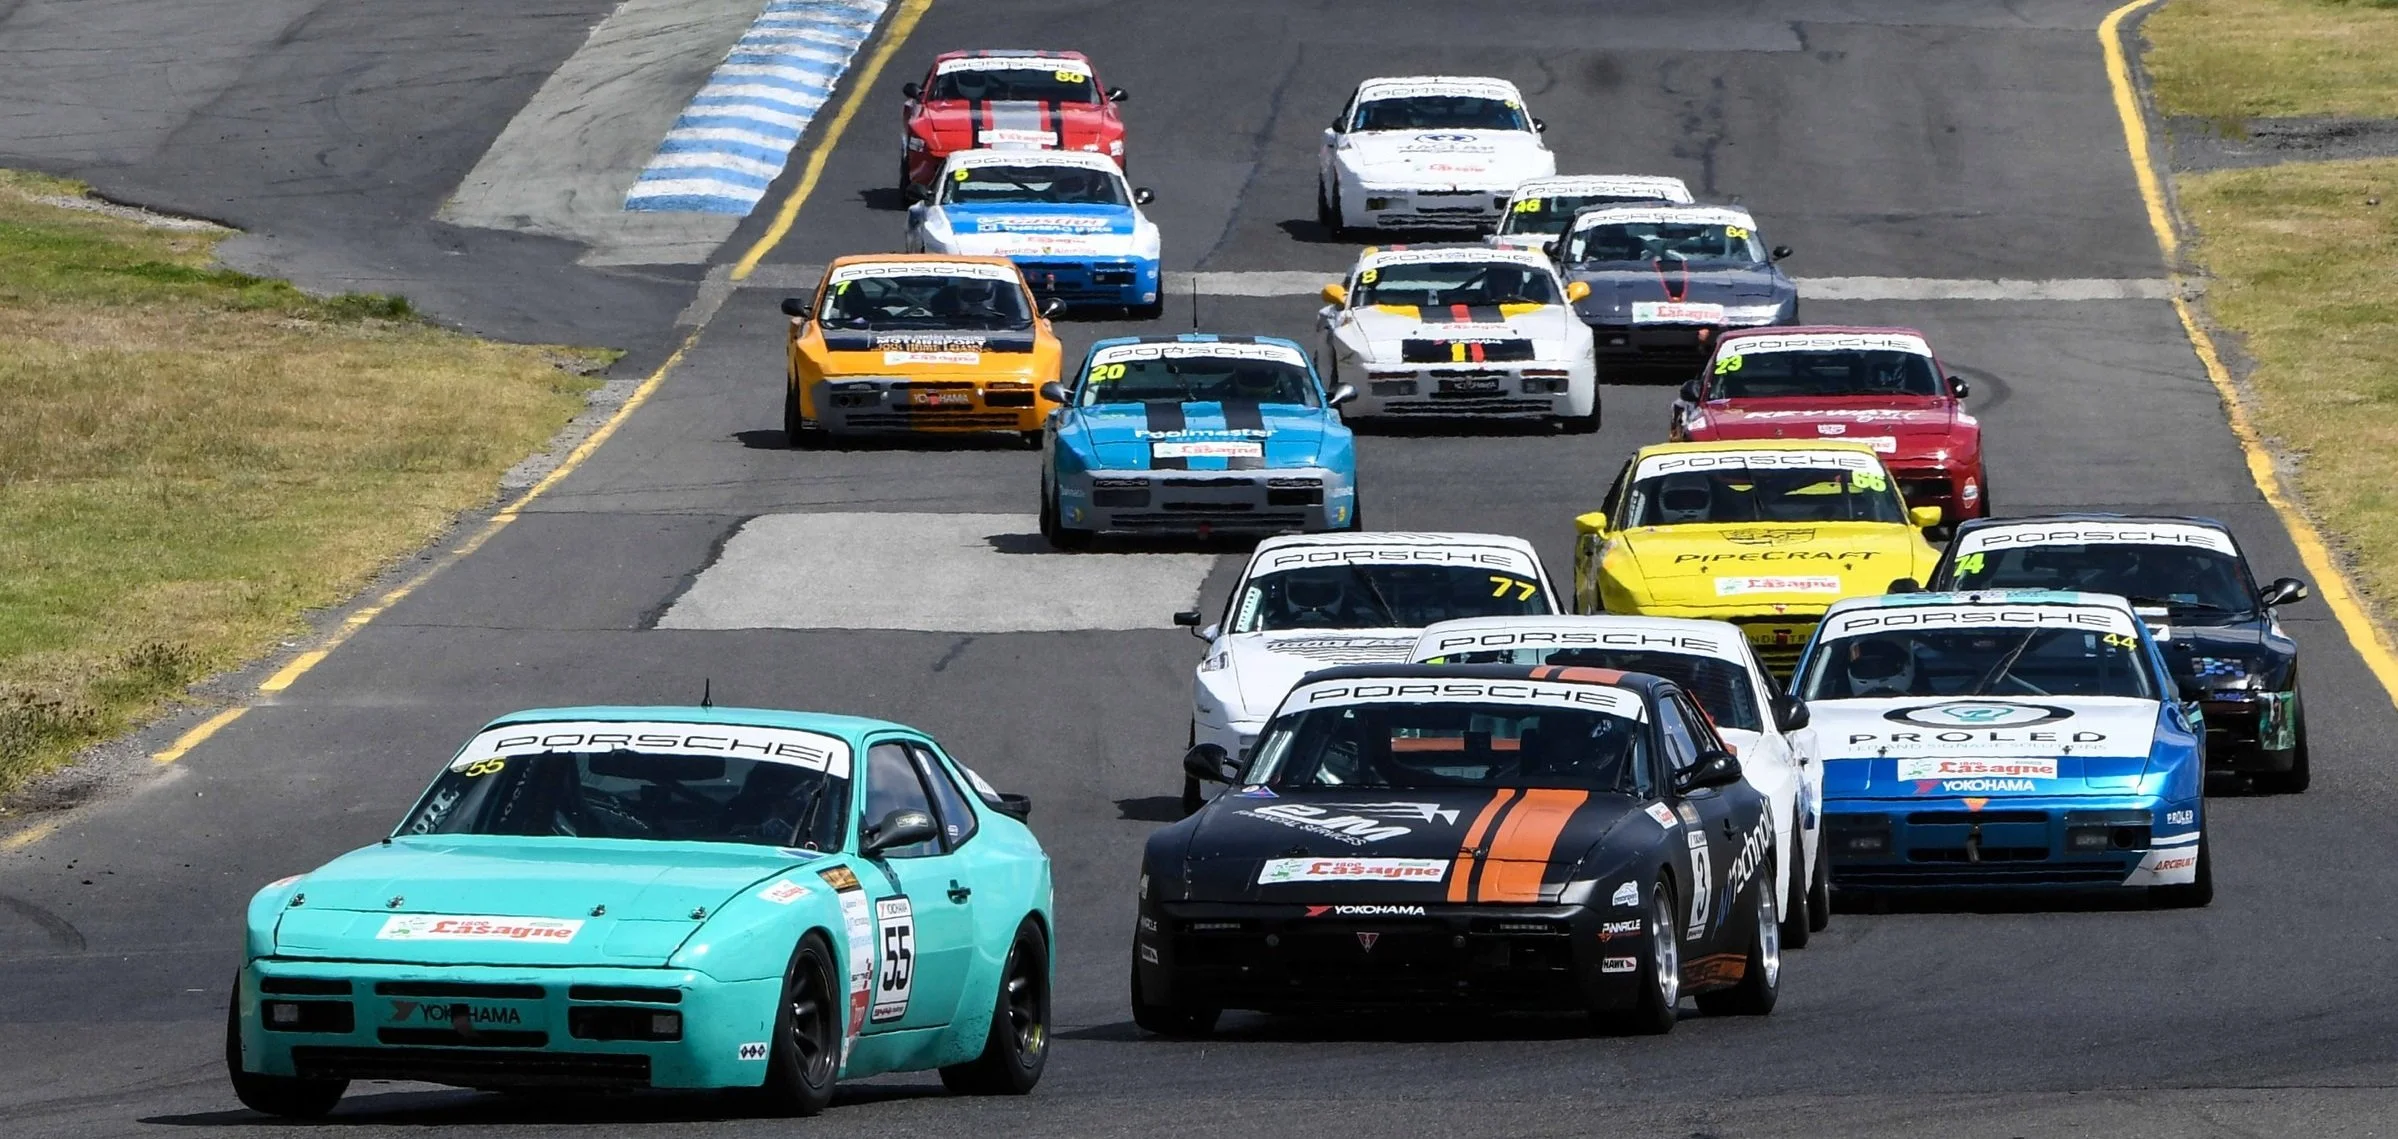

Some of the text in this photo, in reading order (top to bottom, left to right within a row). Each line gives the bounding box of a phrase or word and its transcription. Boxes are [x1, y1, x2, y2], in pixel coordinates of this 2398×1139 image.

[954, 168, 969, 182] 5
[1513, 199, 1542, 214] 46
[840, 266, 1000, 279] PORSCHE
[1361, 269, 1378, 284] 8
[837, 280, 852, 296] 7
[1109, 346, 1289, 360] PORSCHE
[1734, 338, 1912, 351] PORSCHE
[1088, 364, 1126, 382] 20
[1714, 355, 1743, 375] 23
[1658, 455, 1866, 471] PORSCHE
[1851, 470, 1886, 492] 66
[1981, 531, 2216, 548] PORSCHE
[1274, 550, 1512, 568] PORSCHE
[1675, 551, 1882, 564] PIPECRAFT
[1954, 553, 1985, 577] 74
[1489, 576, 1537, 602] 77
[1844, 611, 2112, 632] PORSCHE
[1439, 632, 1719, 654] PORSCHE
[2103, 633, 2137, 651] 44
[1309, 684, 1618, 708] PORSCHE
[1850, 731, 2107, 745] PROLED
[494, 733, 825, 764] PORSCHE
[465, 757, 505, 778] 55
[1937, 761, 2054, 775] Lasagne
[1942, 780, 2036, 792] YOKOHAMA
[1305, 861, 1442, 878] Lasagne
[1697, 851, 1708, 921] 3
[1334, 905, 1426, 917] YOKOHAMA
[428, 920, 573, 938] Lasagne
[1602, 919, 1641, 934] PINNACLE
[882, 925, 911, 992] 55
[1603, 959, 1625, 969] HAWK
[419, 1003, 522, 1025] YOKHAMA
